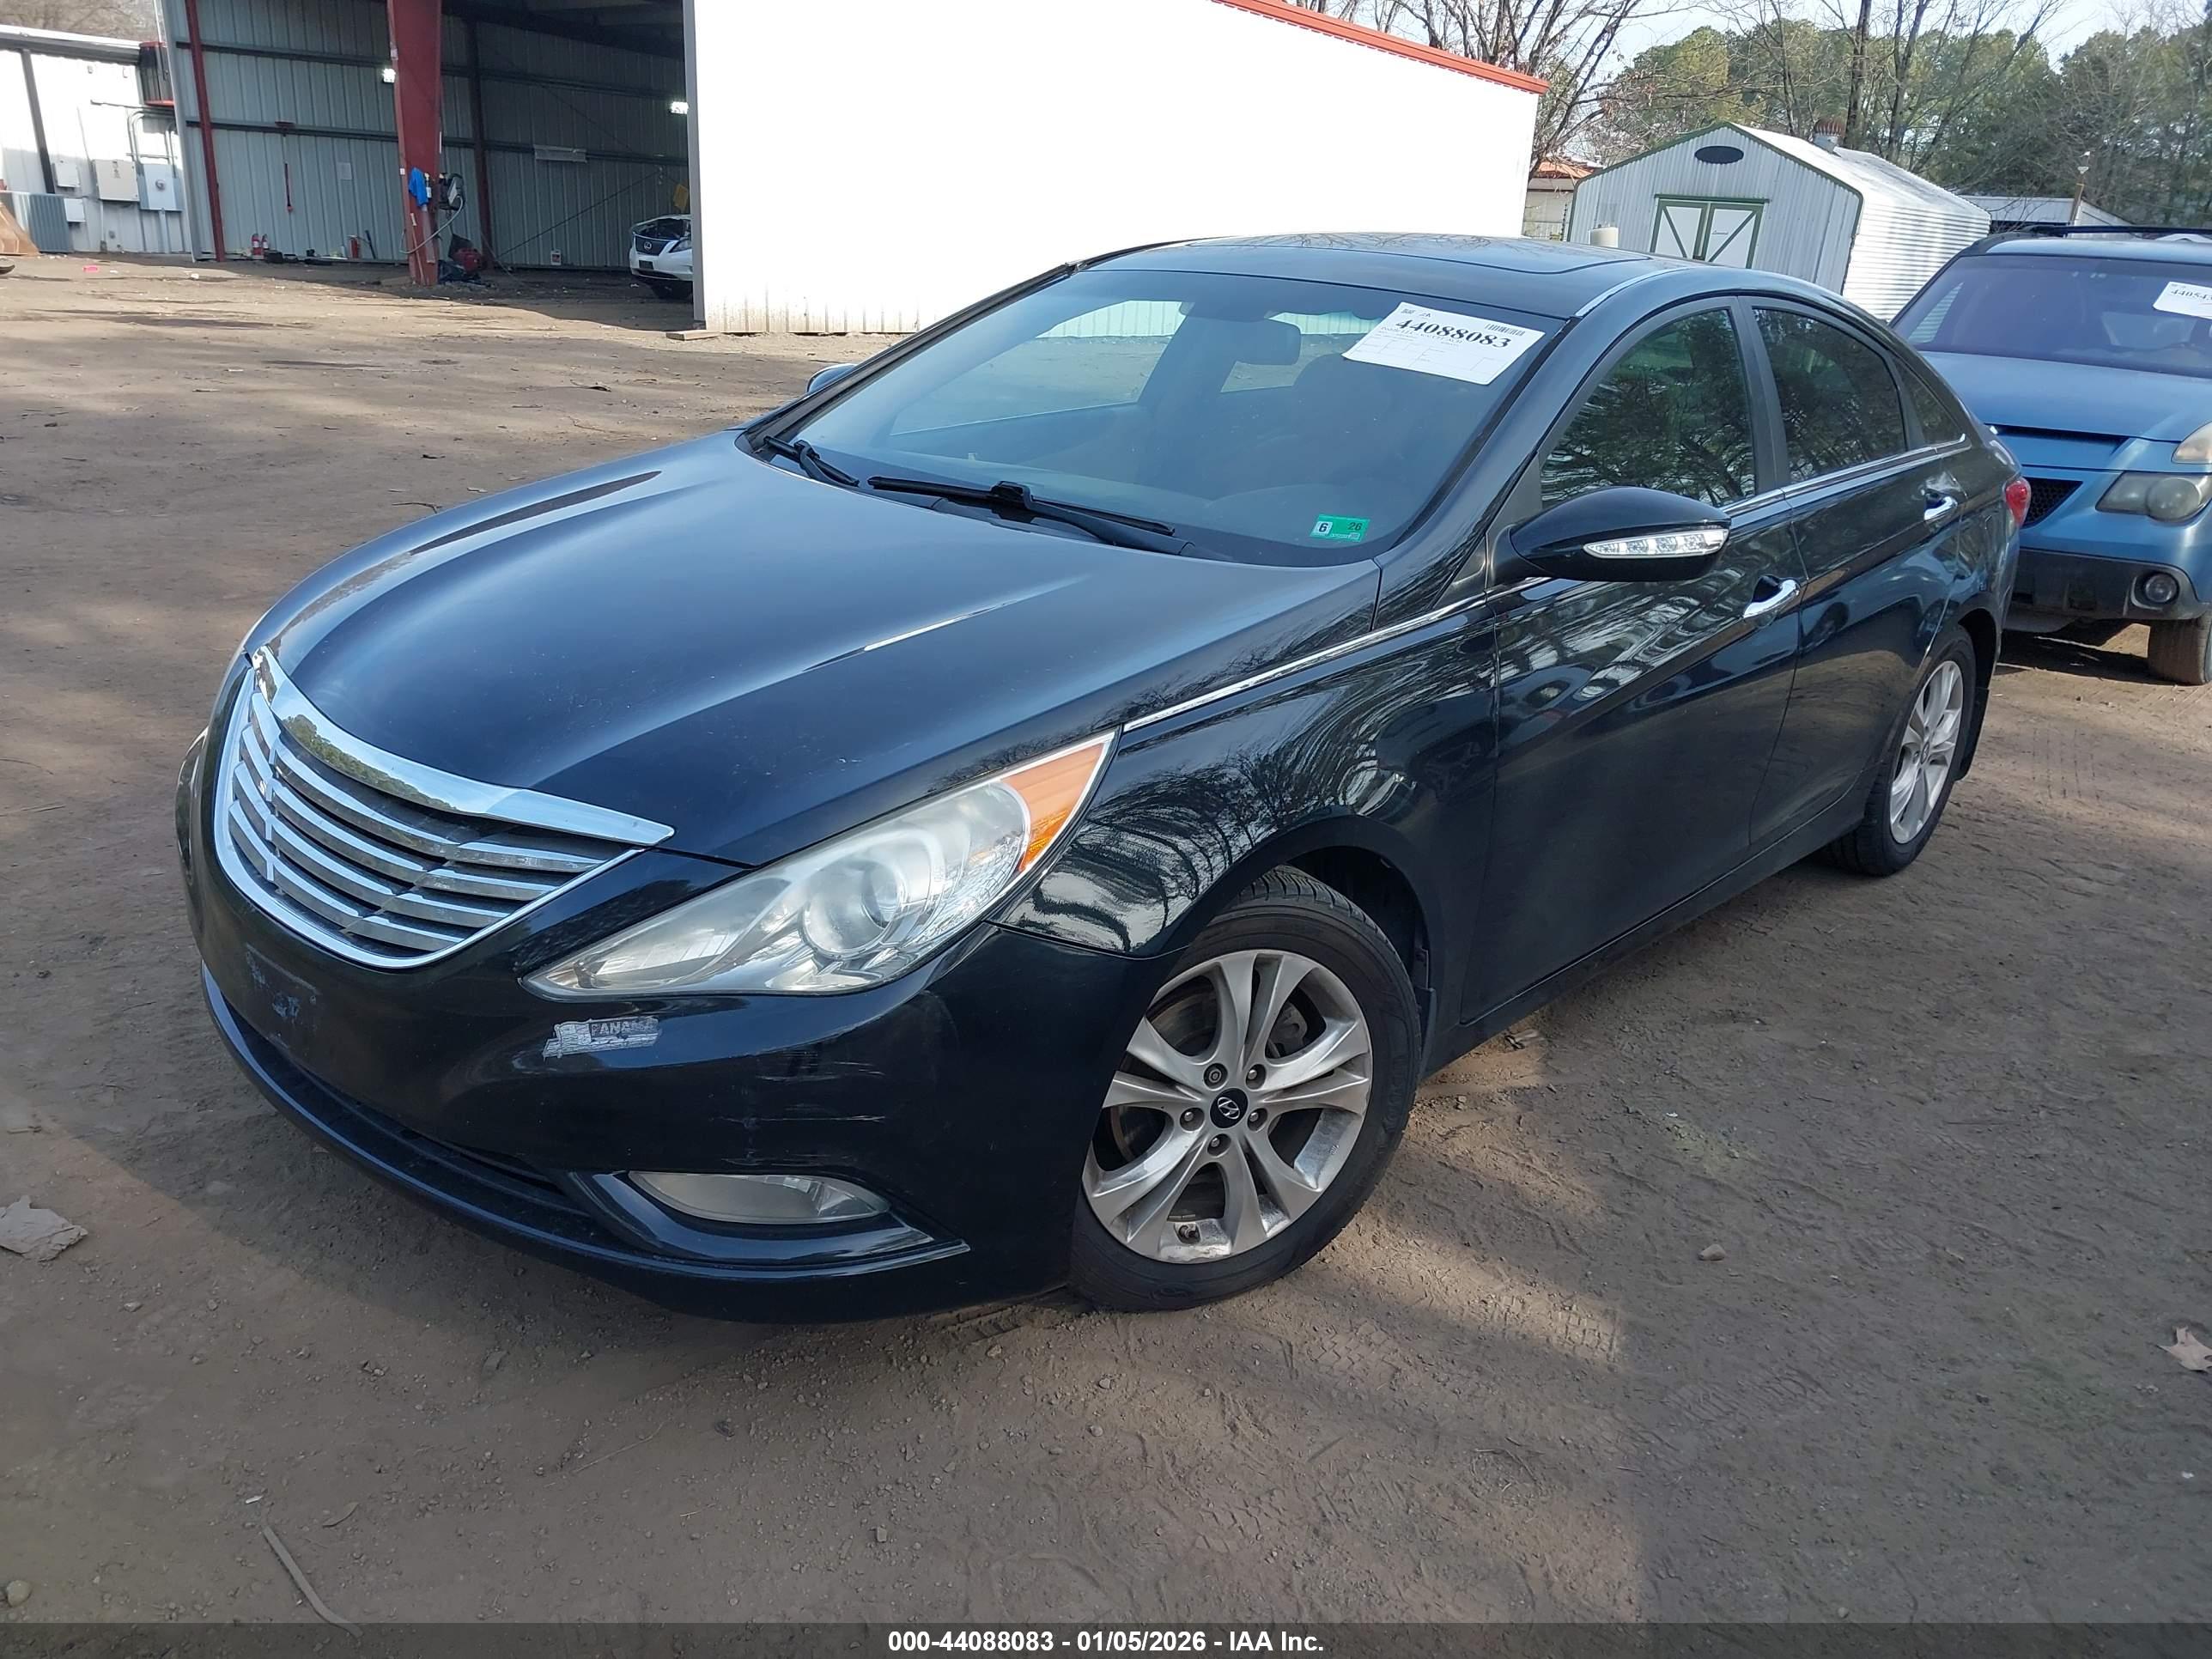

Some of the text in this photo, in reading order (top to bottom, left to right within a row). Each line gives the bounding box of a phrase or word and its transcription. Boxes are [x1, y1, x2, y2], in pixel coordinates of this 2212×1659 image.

[1395, 319, 1511, 348] 44088083
[1319, 522, 1363, 532] 6 26
[591, 1018, 657, 1036] PANA
